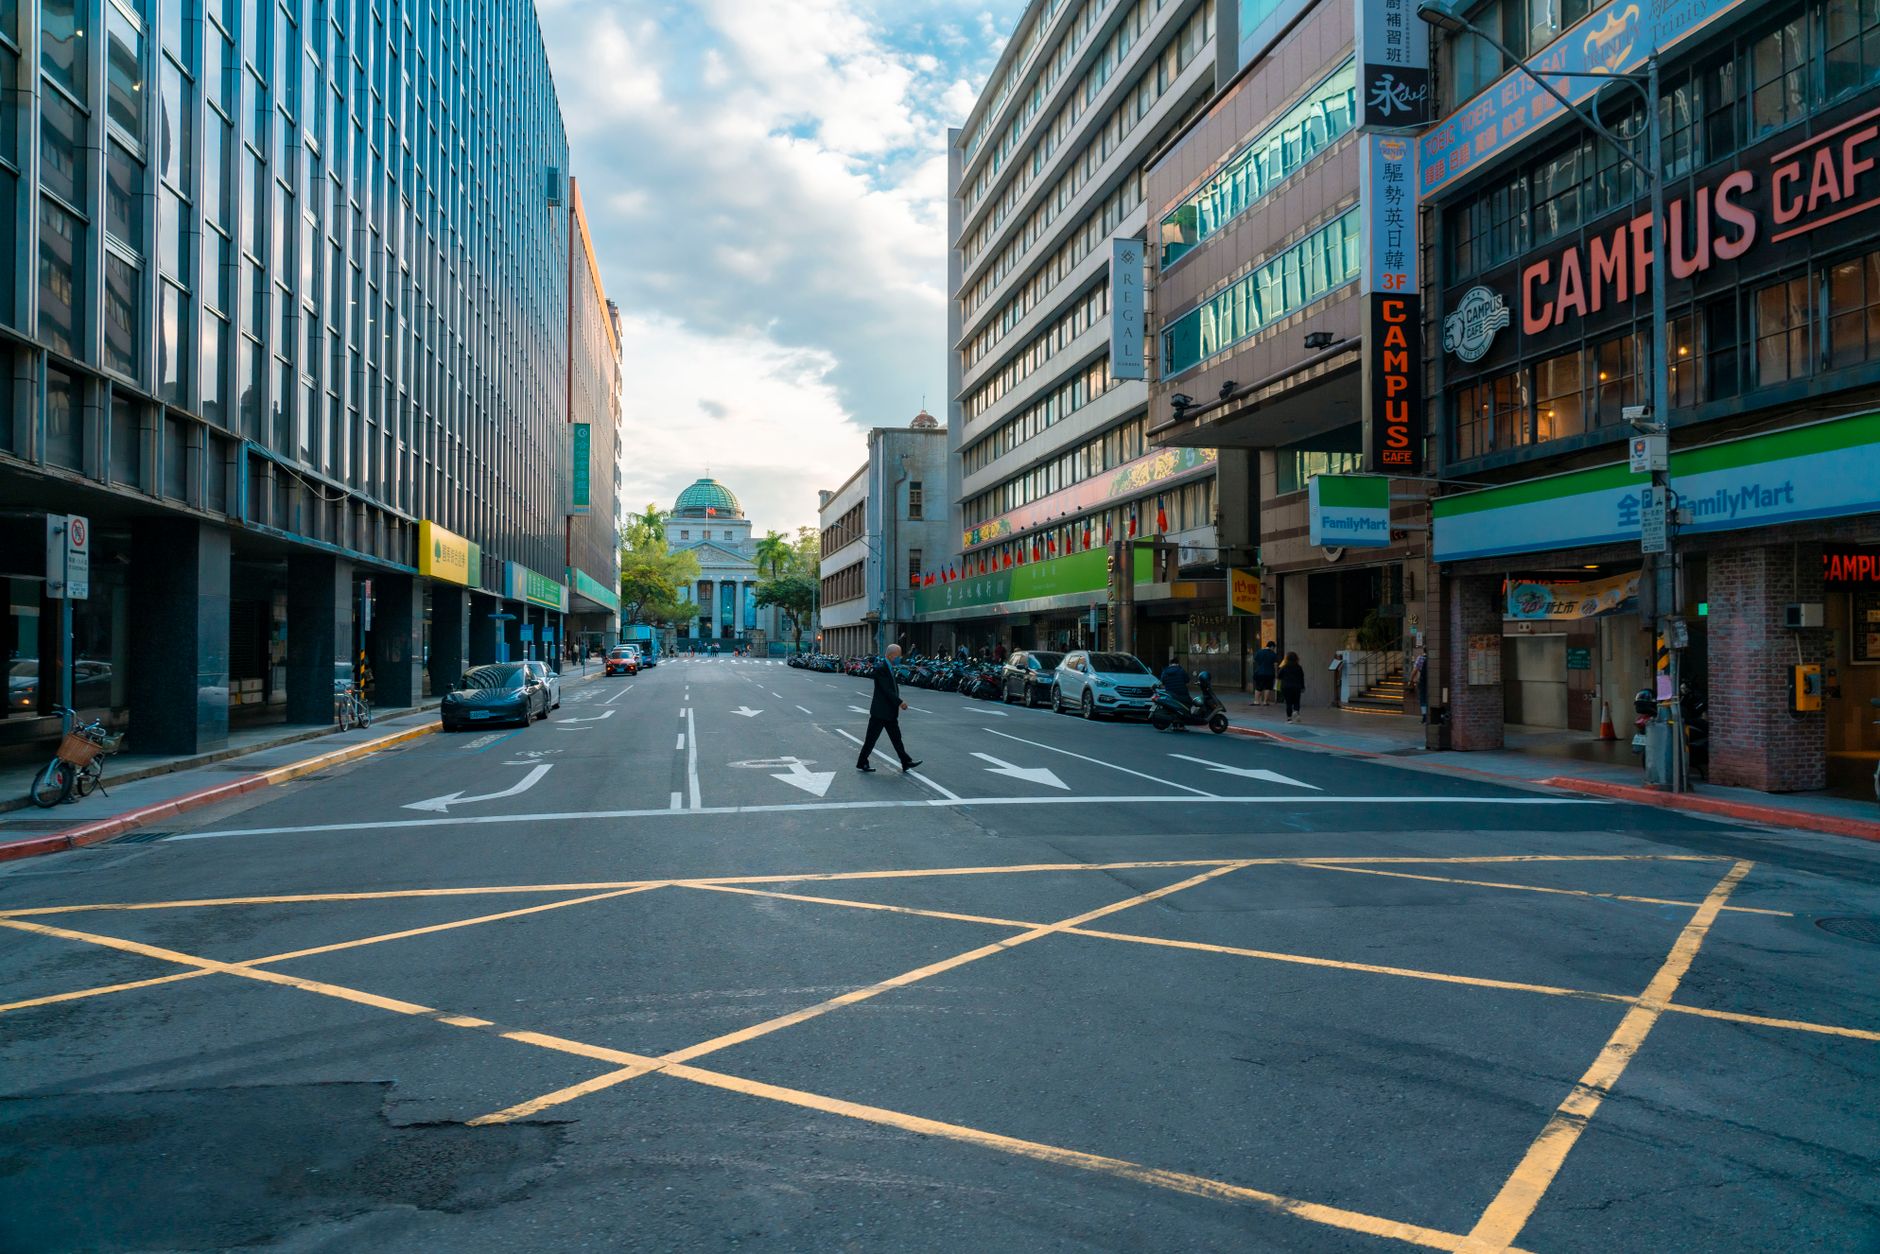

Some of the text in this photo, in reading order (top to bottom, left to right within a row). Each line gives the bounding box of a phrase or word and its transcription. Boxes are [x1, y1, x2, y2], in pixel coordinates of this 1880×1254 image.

[1368, 73, 1412, 117] 永
[1425, 124, 1455, 159] TOEIC
[1459, 98, 1497, 134] TOEFL
[1501, 74, 1536, 109] IELTS
[1382, 162, 1405, 270] 驅勢英日韓
[1523, 170, 1757, 335] CAMPUS
[1382, 273, 1407, 290] 3F
[1122, 273, 1134, 357] REGAL
[1466, 294, 1503, 324] CAMPUS
[1466, 323, 1484, 339] CAFE
[1383, 300, 1409, 448] CAMPUS
[1383, 452, 1412, 462] CAFE
[1678, 480, 1794, 519] FamilyMart
[1322, 516, 1387, 532] FamilyMart
[1408, 613, 1418, 624] 42
[1545, 600, 1579, 615] 新上市
